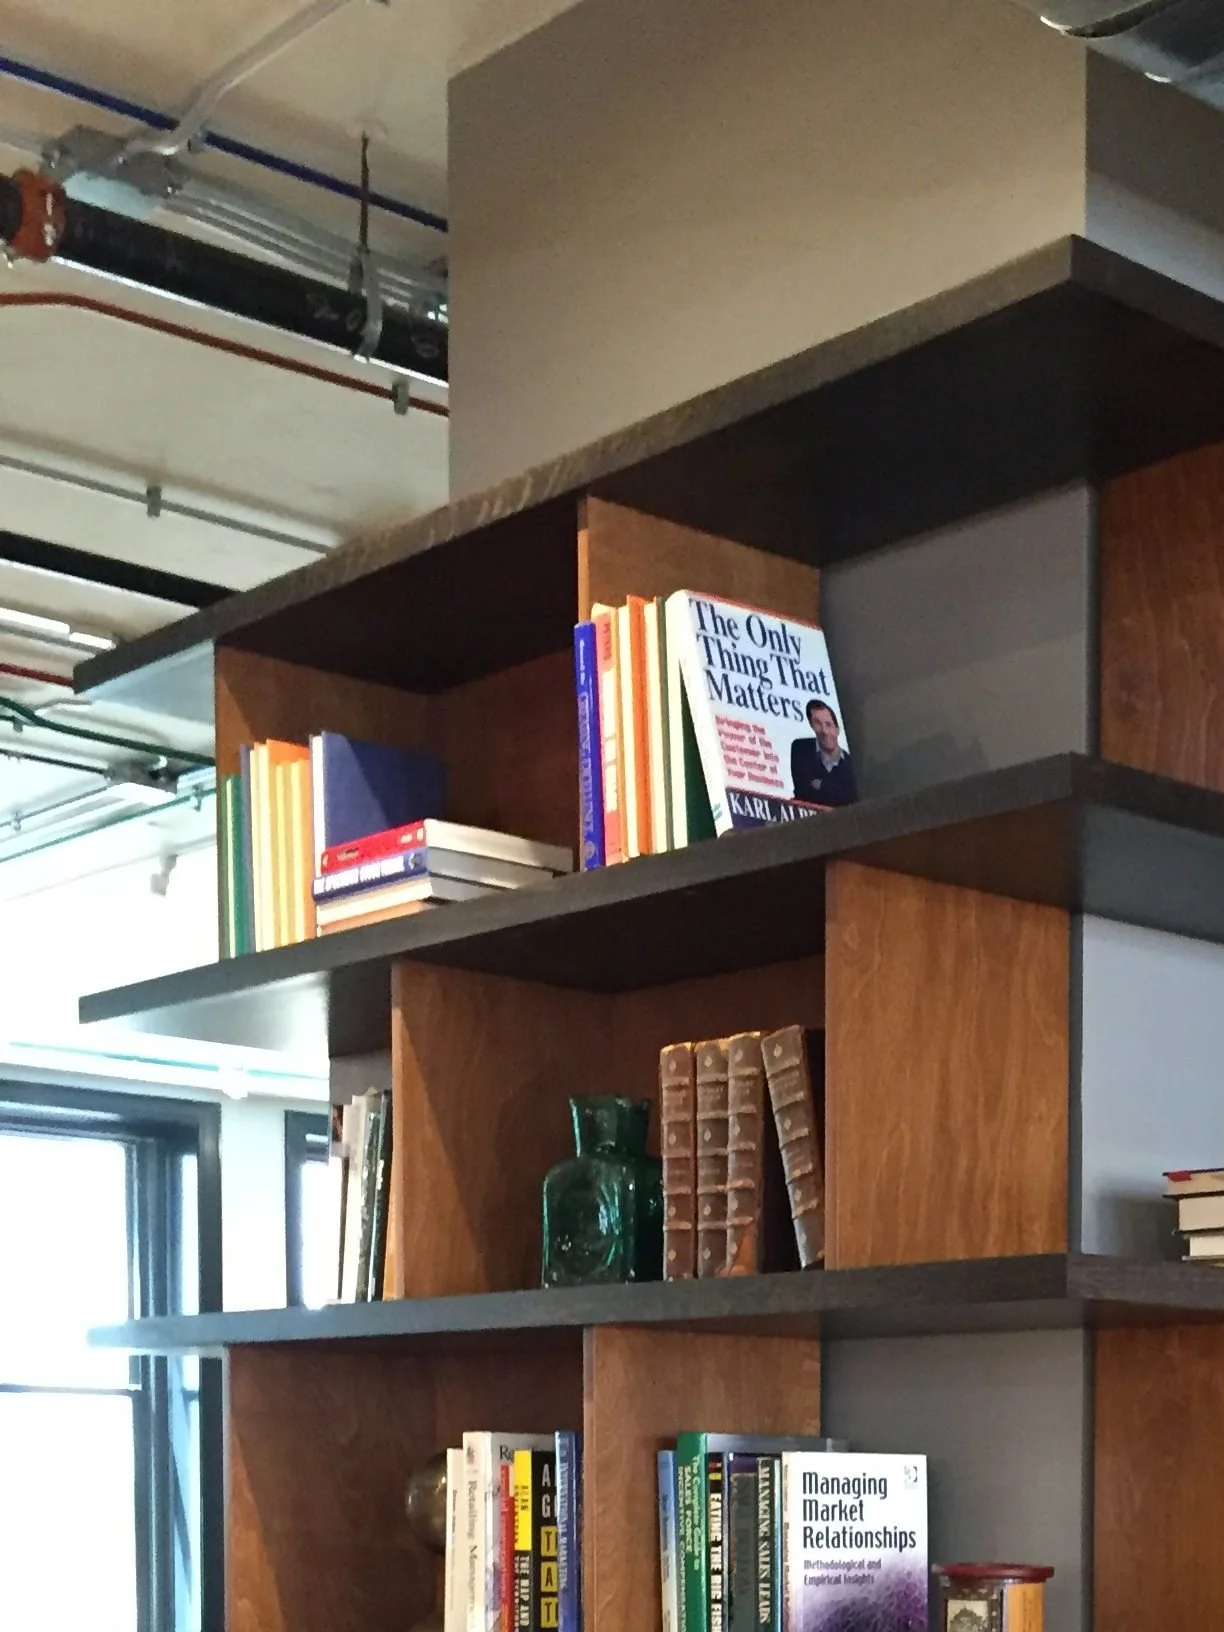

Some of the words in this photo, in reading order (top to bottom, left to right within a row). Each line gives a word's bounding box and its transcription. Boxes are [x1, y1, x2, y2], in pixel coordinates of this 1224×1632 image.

[688, 598, 740, 640] The
[746, 614, 800, 663] Only
[696, 633, 773, 690] Thing
[770, 654, 830, 696] That
[704, 669, 804, 722] Matters
[729, 792, 777, 822] KARL
[684, 1465, 692, 1505] SALES
[758, 1465, 770, 1537] MANAGING
[802, 1471, 888, 1500] Managing
[710, 1493, 722, 1541] EATING
[802, 1499, 865, 1522] Market
[803, 1525, 917, 1552] Relationships
[710, 1545, 722, 1570] THE
[758, 1541, 770, 1579] SALES
[803, 1559, 865, 1574] Methodological
[867, 1559, 882, 1570] and
[710, 1574, 722, 1600] BIG
[803, 1574, 841, 1586] Empirical
[843, 1574, 875, 1585] Insights
[758, 1583, 770, 1623] LEADS
